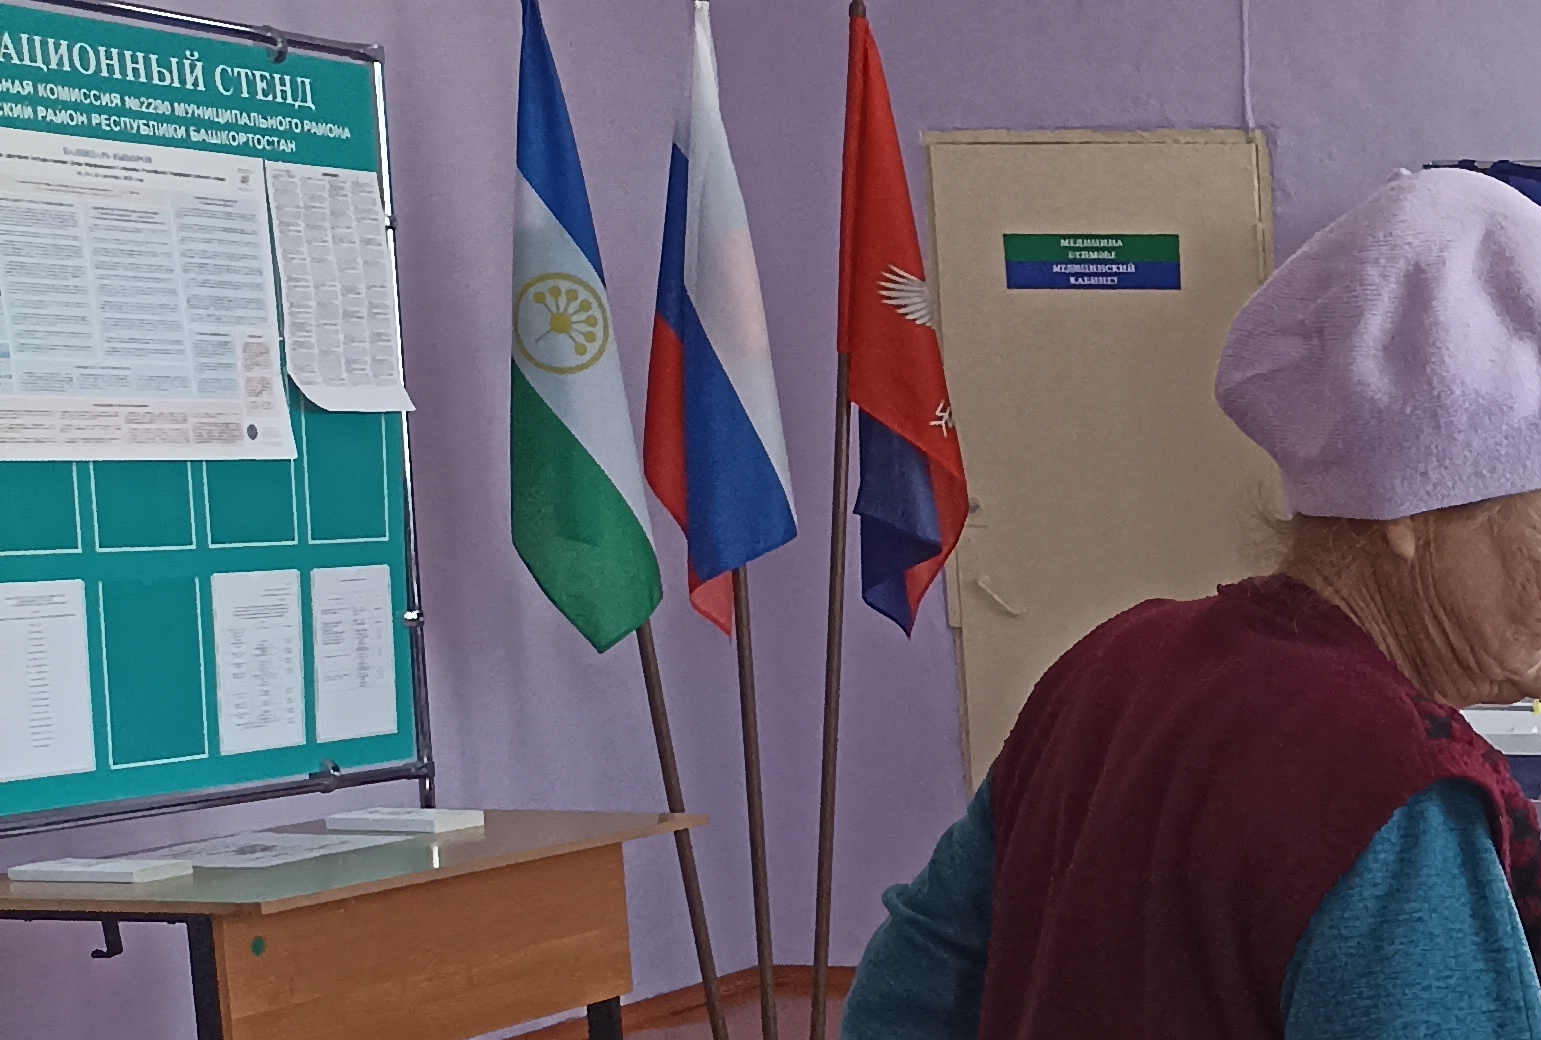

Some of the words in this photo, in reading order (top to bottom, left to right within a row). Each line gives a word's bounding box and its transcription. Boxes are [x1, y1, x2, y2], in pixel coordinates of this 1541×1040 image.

[38, 83, 122, 107] КОМИССИЯ
[174, 102, 301, 133] МУНИЦИПАЛЬНОГО
[214, 64, 316, 111] СТЕНД
[37, 105, 88, 126] РАЙОН
[91, 113, 187, 139] РЕСПУБЛИКИ
[189, 126, 296, 153] БАШКОРТОСТАН
